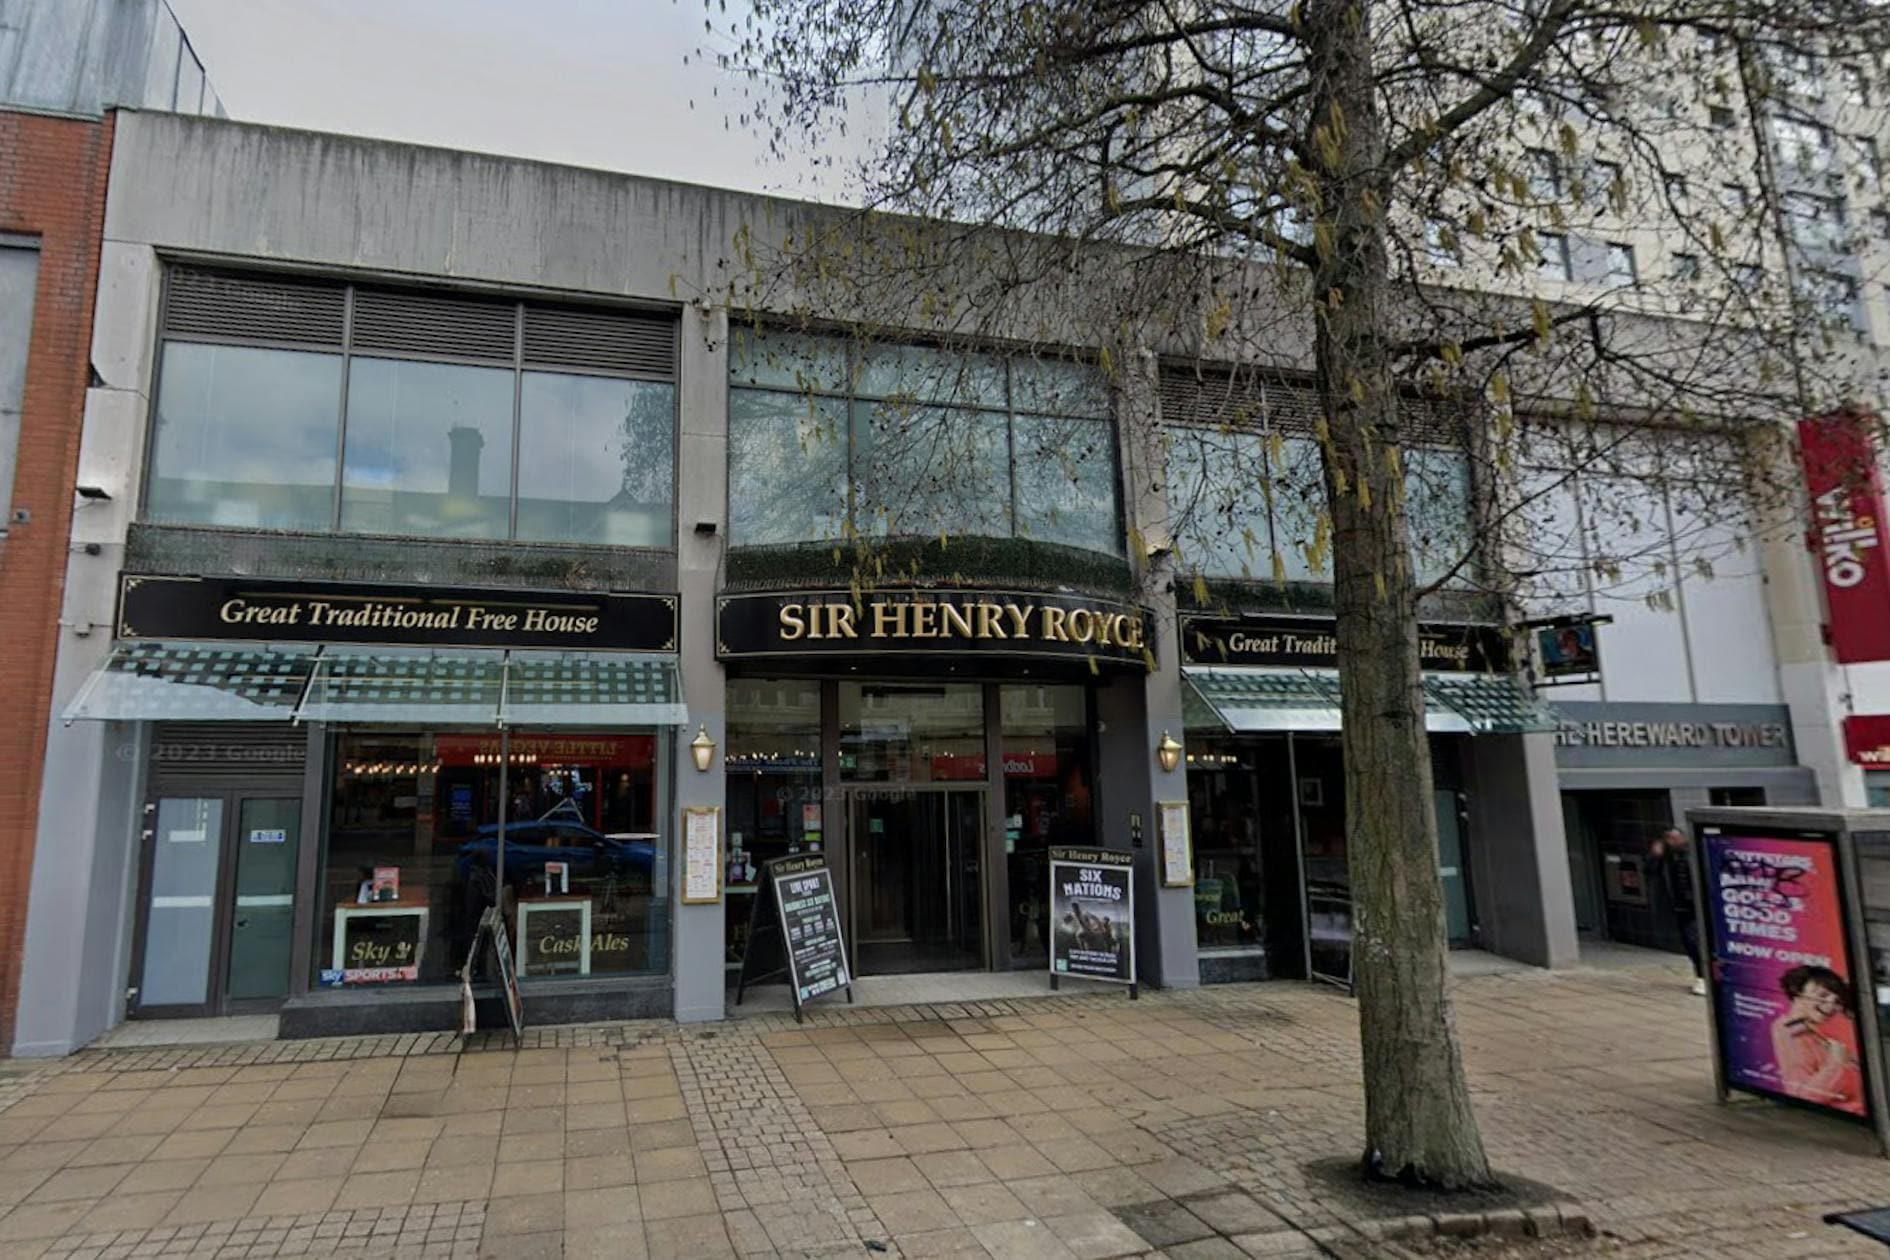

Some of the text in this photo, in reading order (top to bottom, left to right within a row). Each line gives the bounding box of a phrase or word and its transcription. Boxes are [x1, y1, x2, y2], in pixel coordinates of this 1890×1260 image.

[1815, 485, 1878, 588] wilko
[219, 598, 599, 634] Great Traditional Free House
[778, 601, 1145, 649] SIR HENRY ROYCE
[1229, 632, 1469, 660] Great Tradit House
[1553, 720, 1788, 749] HE HEREWARD TOWER
[1068, 850, 1099, 862] Henry
[1101, 852, 1132, 864] Royce
[1079, 868, 1103, 883] SIX
[1063, 881, 1122, 901] NATIONS
[1206, 908, 1246, 925] Great
[1725, 917, 1798, 942] TIMES
[351, 941, 390, 962] Sky
[590, 932, 630, 952] Ales
[1726, 941, 1833, 969] NOW OPEN
[344, 967, 397, 981] SPORTS
